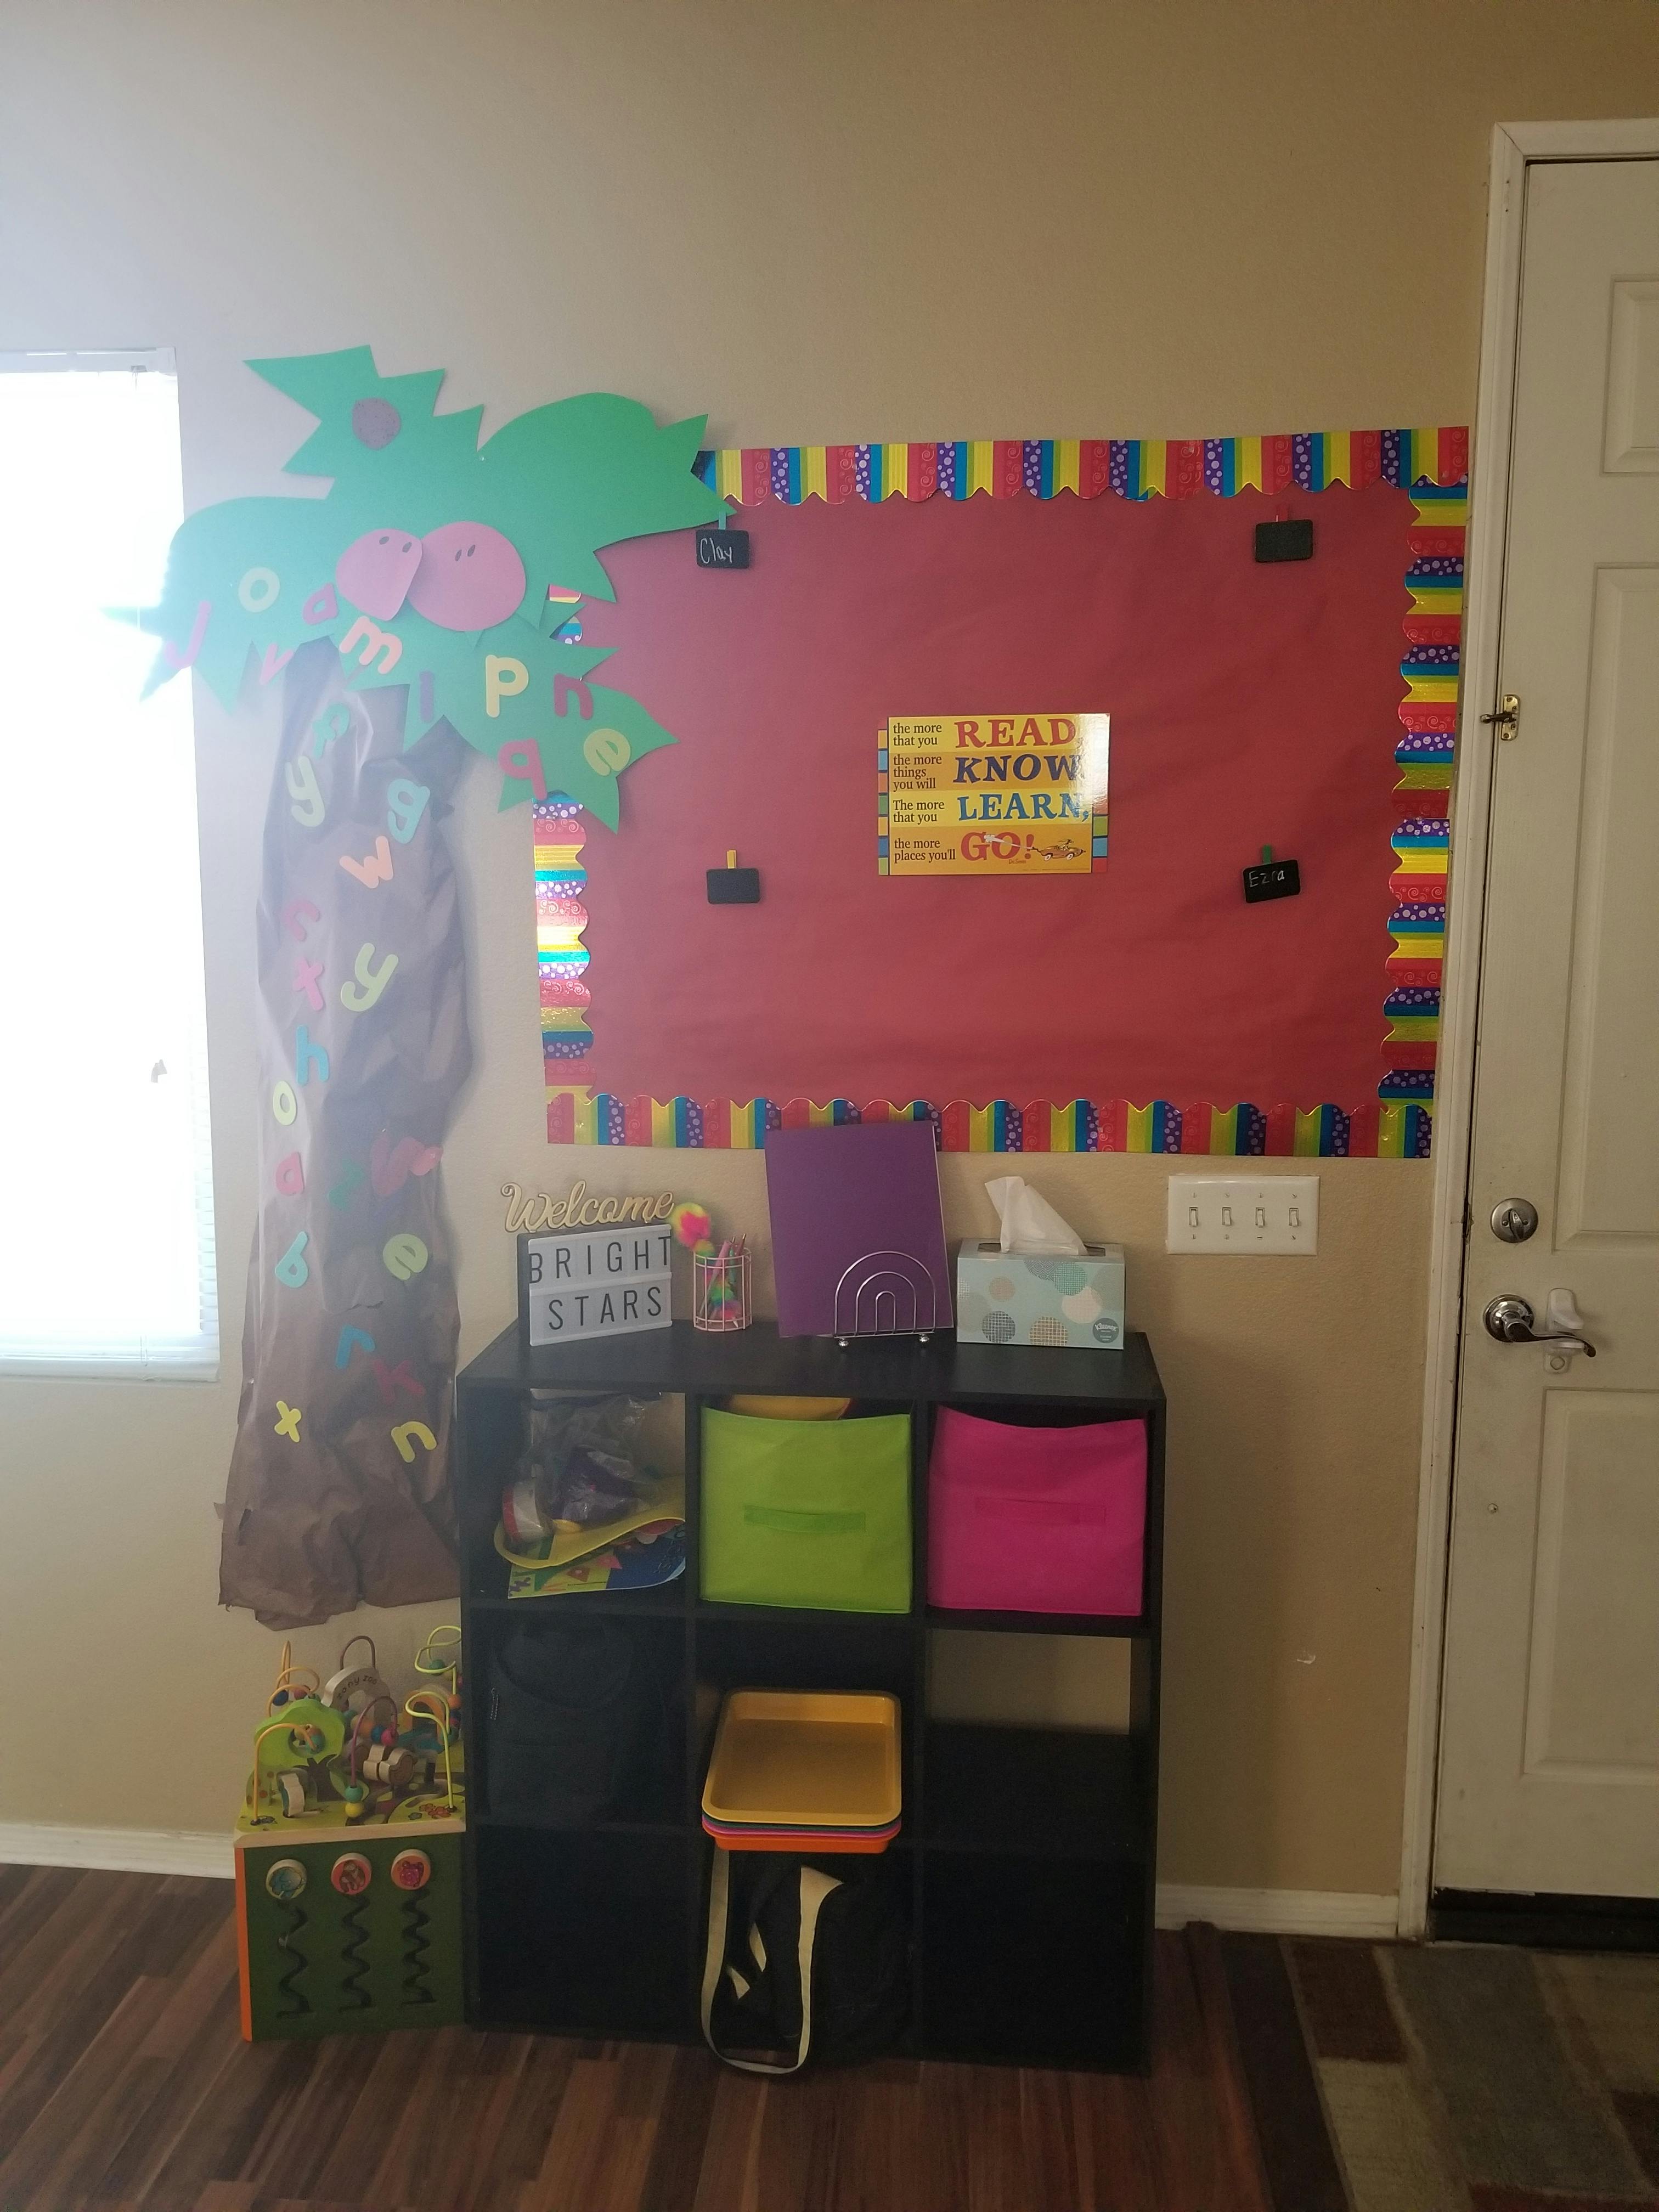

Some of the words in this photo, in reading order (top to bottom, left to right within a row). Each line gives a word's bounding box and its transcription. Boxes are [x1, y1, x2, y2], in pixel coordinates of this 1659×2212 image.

[700, 537, 732, 564] Clay
[339, 616, 403, 674] m
[485, 654, 529, 718] p
[554, 673, 594, 720] n
[893, 723, 910, 734] the
[913, 724, 942, 733] more
[893, 735, 915, 746] that
[917, 737, 938, 748] you
[583, 728, 631, 776] e
[894, 754, 911, 766] the
[913, 755, 943, 765] more
[894, 766, 927, 780] things
[285, 755, 325, 827] y
[893, 781, 913, 792] you
[916, 777, 936, 789] will
[387, 778, 430, 844] g
[893, 799, 913, 810] The
[917, 801, 945, 810] more
[957, 793, 1090, 822] LEARN,
[893, 811, 915, 822] that
[917, 814, 938, 825] you
[339, 836, 394, 889] w
[894, 838, 911, 849] the
[913, 840, 940, 849] more
[961, 831, 1034, 861] GO!
[894, 850, 926, 864] places
[928, 849, 956, 863] you'll
[1249, 870, 1285, 888] Ezra
[341, 943, 399, 1012] y
[296, 1025, 330, 1086] h
[273, 1080, 297, 1126] o
[501, 1180, 674, 1233] Welcome
[383, 1233, 428, 1281] e
[529, 1235, 672, 1284] BRIGHT
[548, 1286, 662, 1330] STARS
[391, 1421, 438, 1463] n
